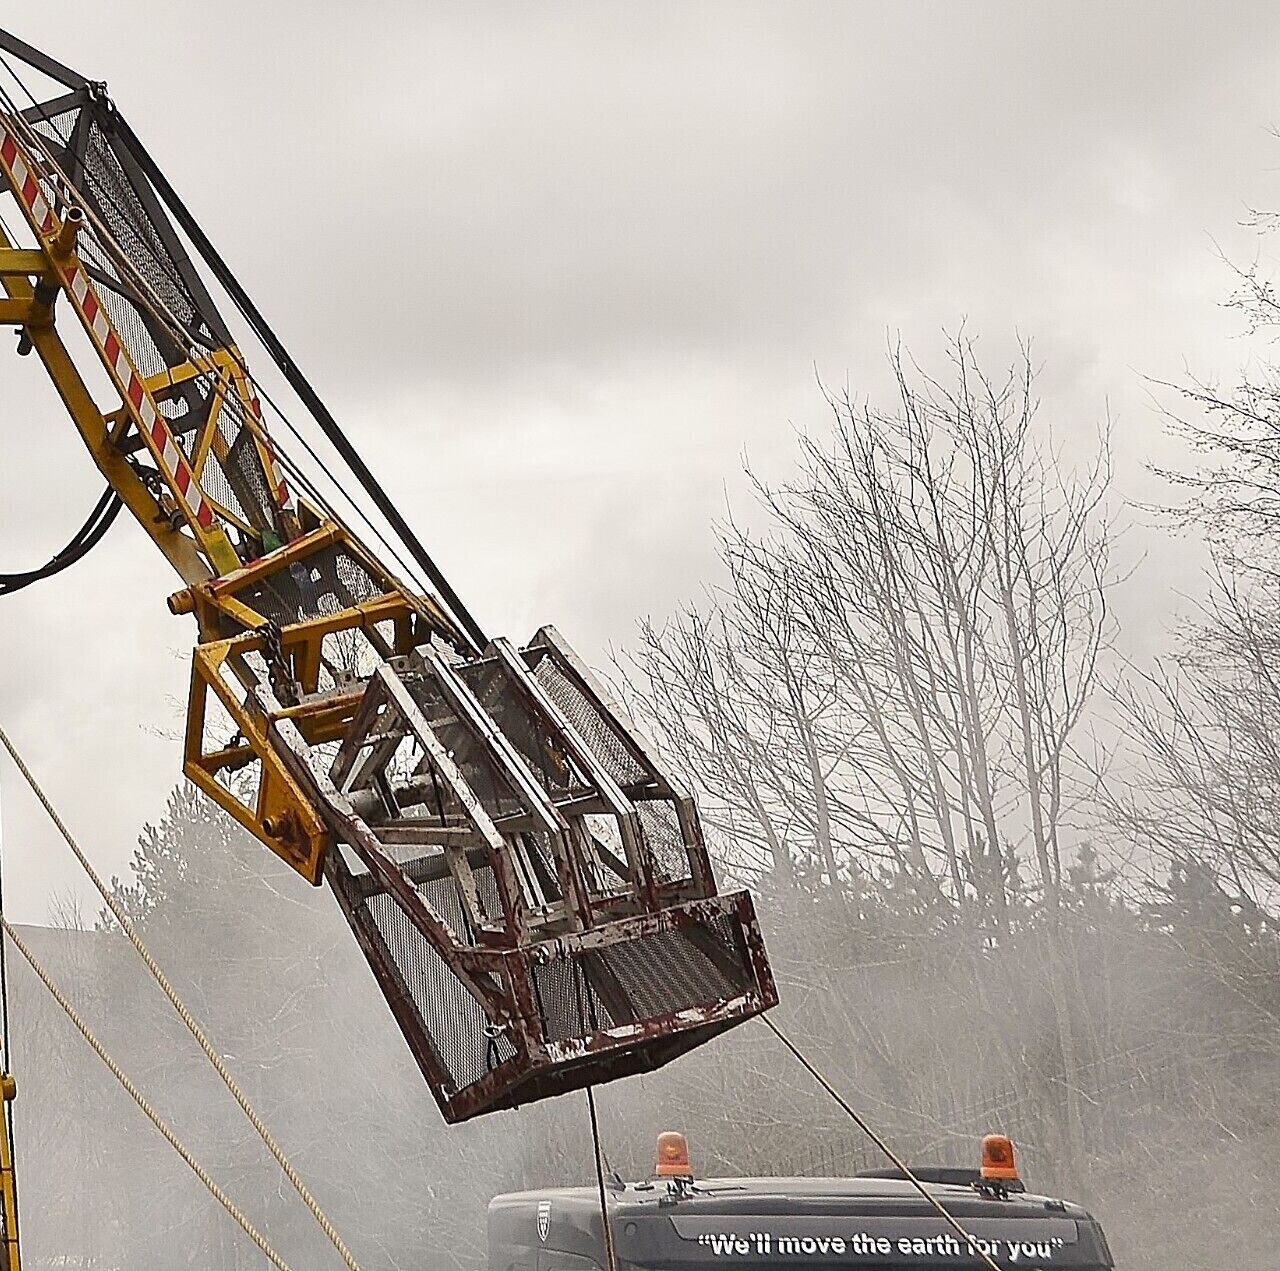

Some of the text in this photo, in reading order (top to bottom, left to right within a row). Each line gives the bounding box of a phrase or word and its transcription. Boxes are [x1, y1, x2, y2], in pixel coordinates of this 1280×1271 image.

[778, 1236, 846, 1254] move
[851, 1232, 891, 1254] the
[897, 1234, 960, 1256] earth
[966, 1234, 1002, 1257] for
